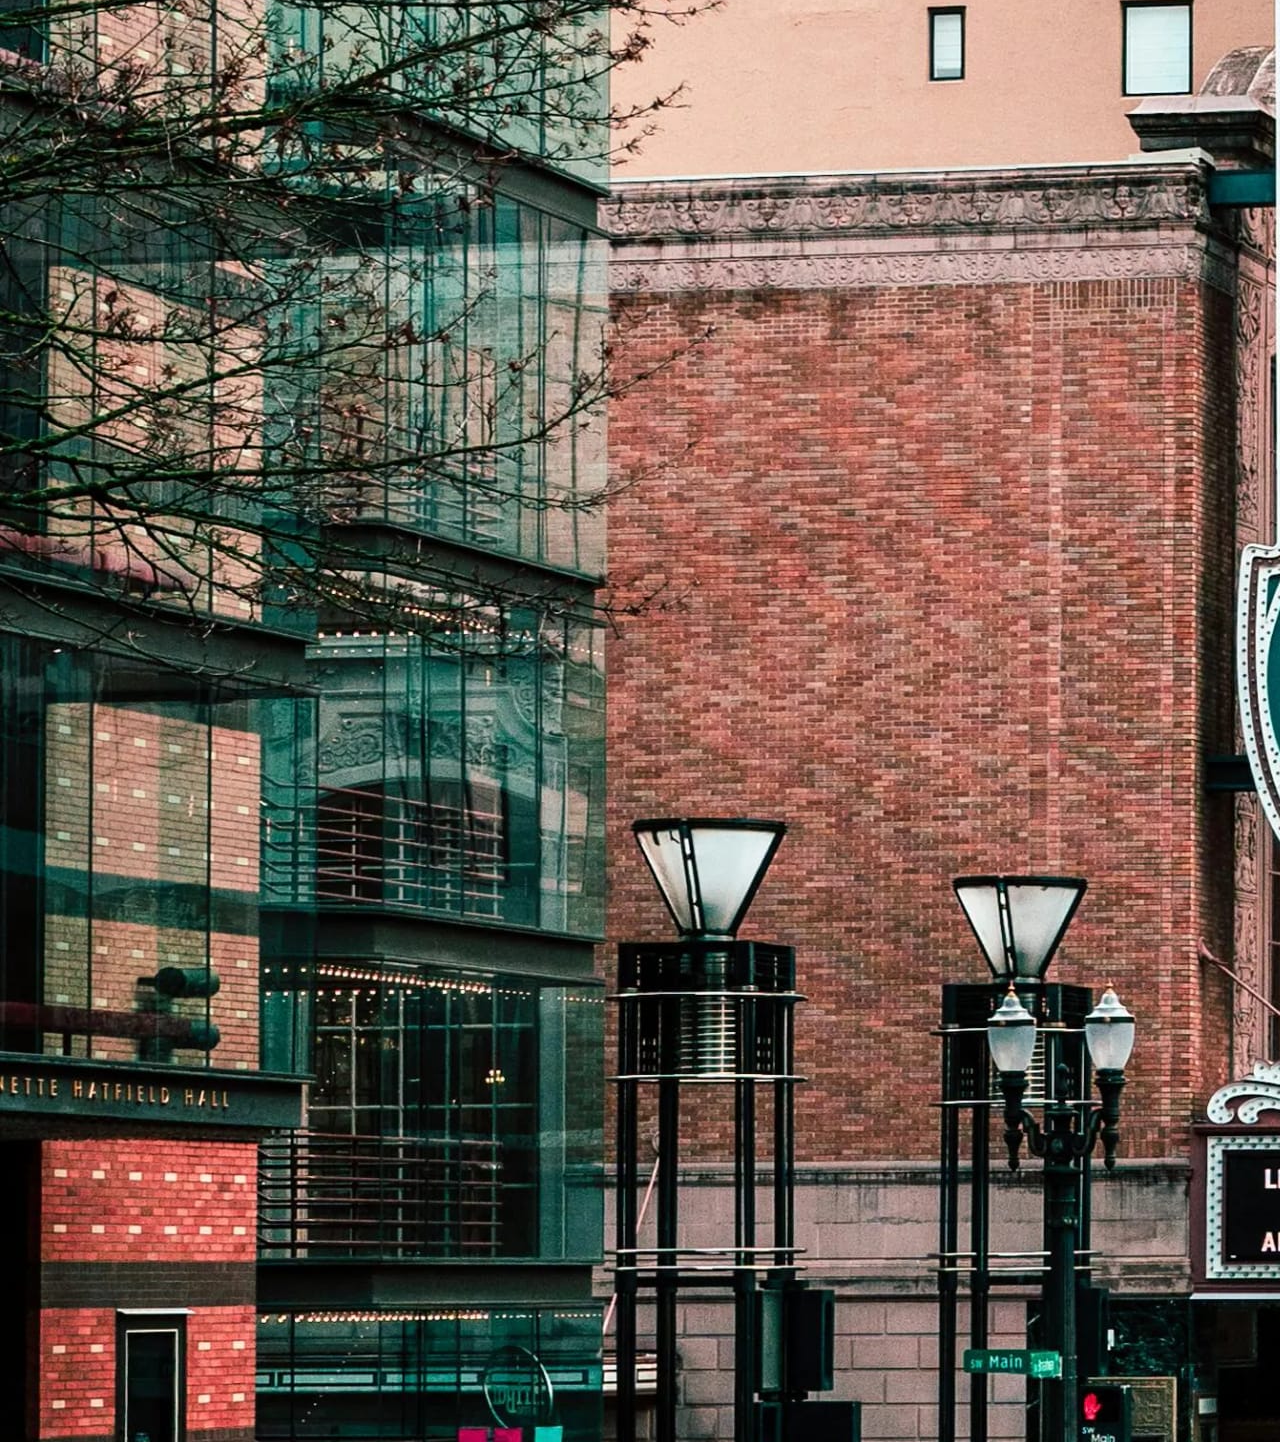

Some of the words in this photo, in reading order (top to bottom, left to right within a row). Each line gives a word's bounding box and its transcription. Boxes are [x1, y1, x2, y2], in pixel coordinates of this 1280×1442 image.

[73, 1080, 170, 1104] HATFIELD
[185, 1089, 230, 1108] HALL
[989, 1355, 1023, 1369] Main
